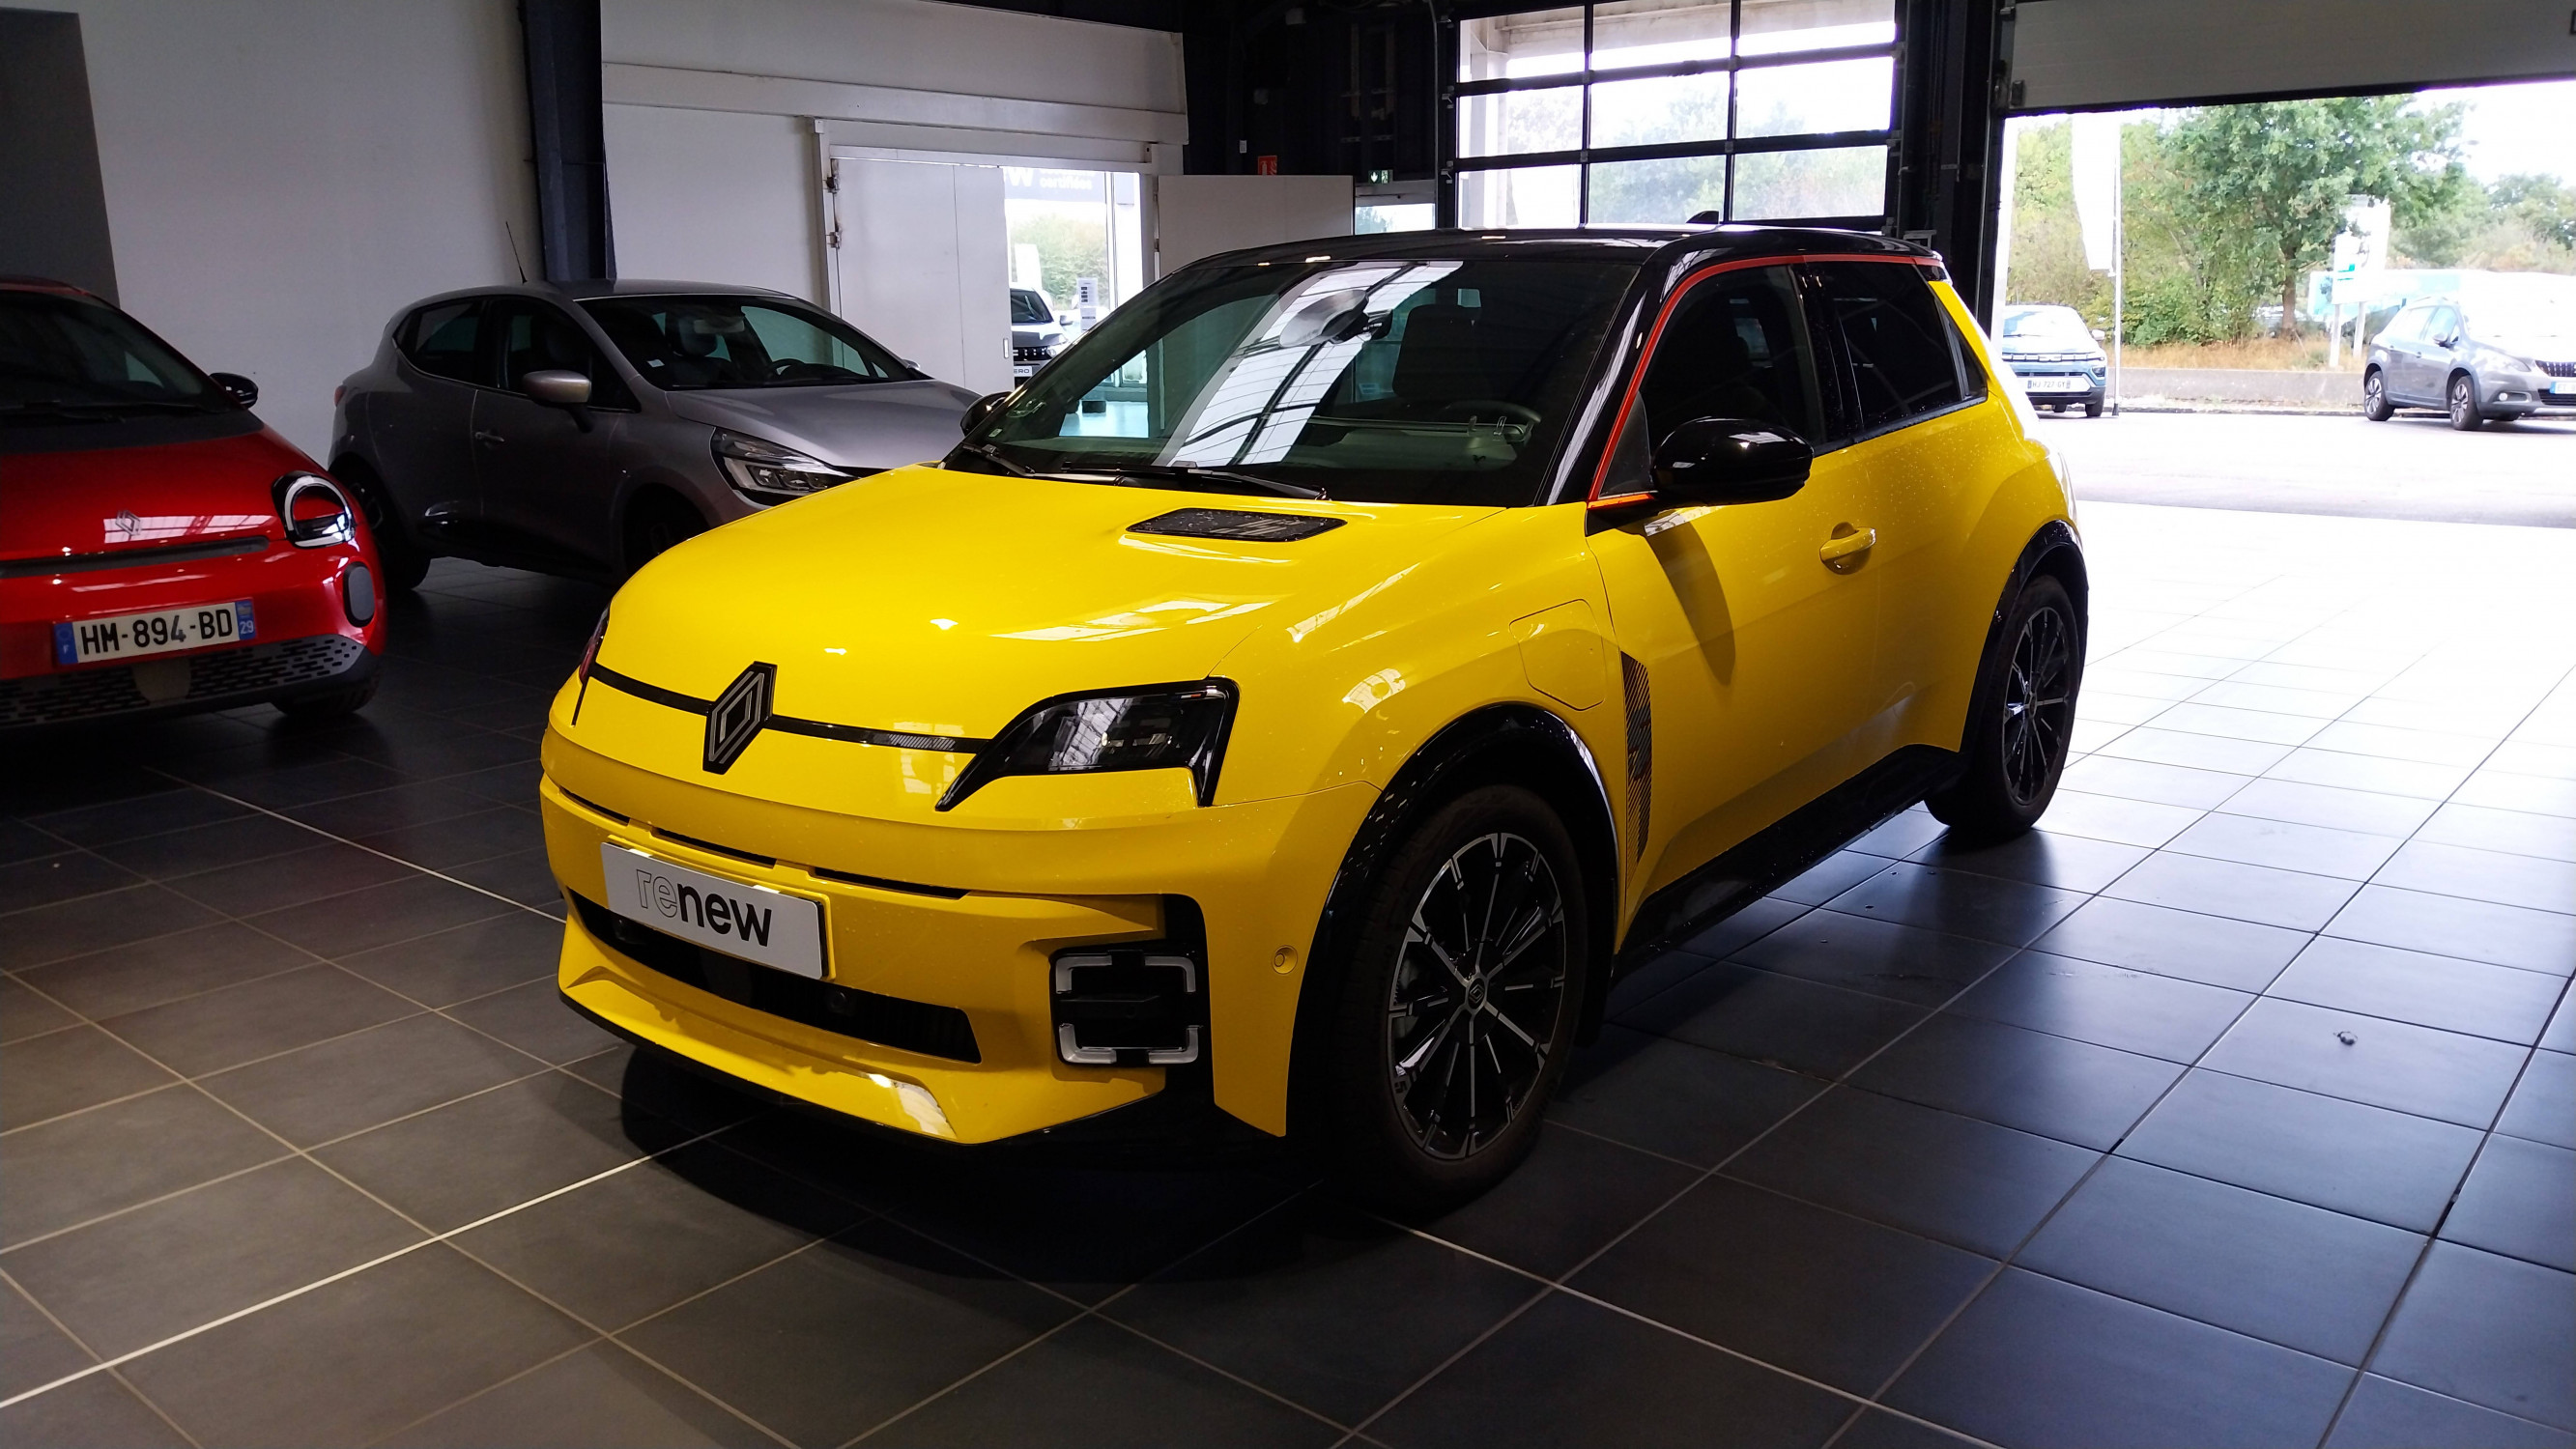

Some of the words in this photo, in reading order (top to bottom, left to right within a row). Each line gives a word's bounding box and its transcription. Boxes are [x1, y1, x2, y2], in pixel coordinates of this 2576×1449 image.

[80, 609, 233, 655] HM-894-BD
[240, 620, 255, 635] 29
[636, 869, 772, 948] renew
